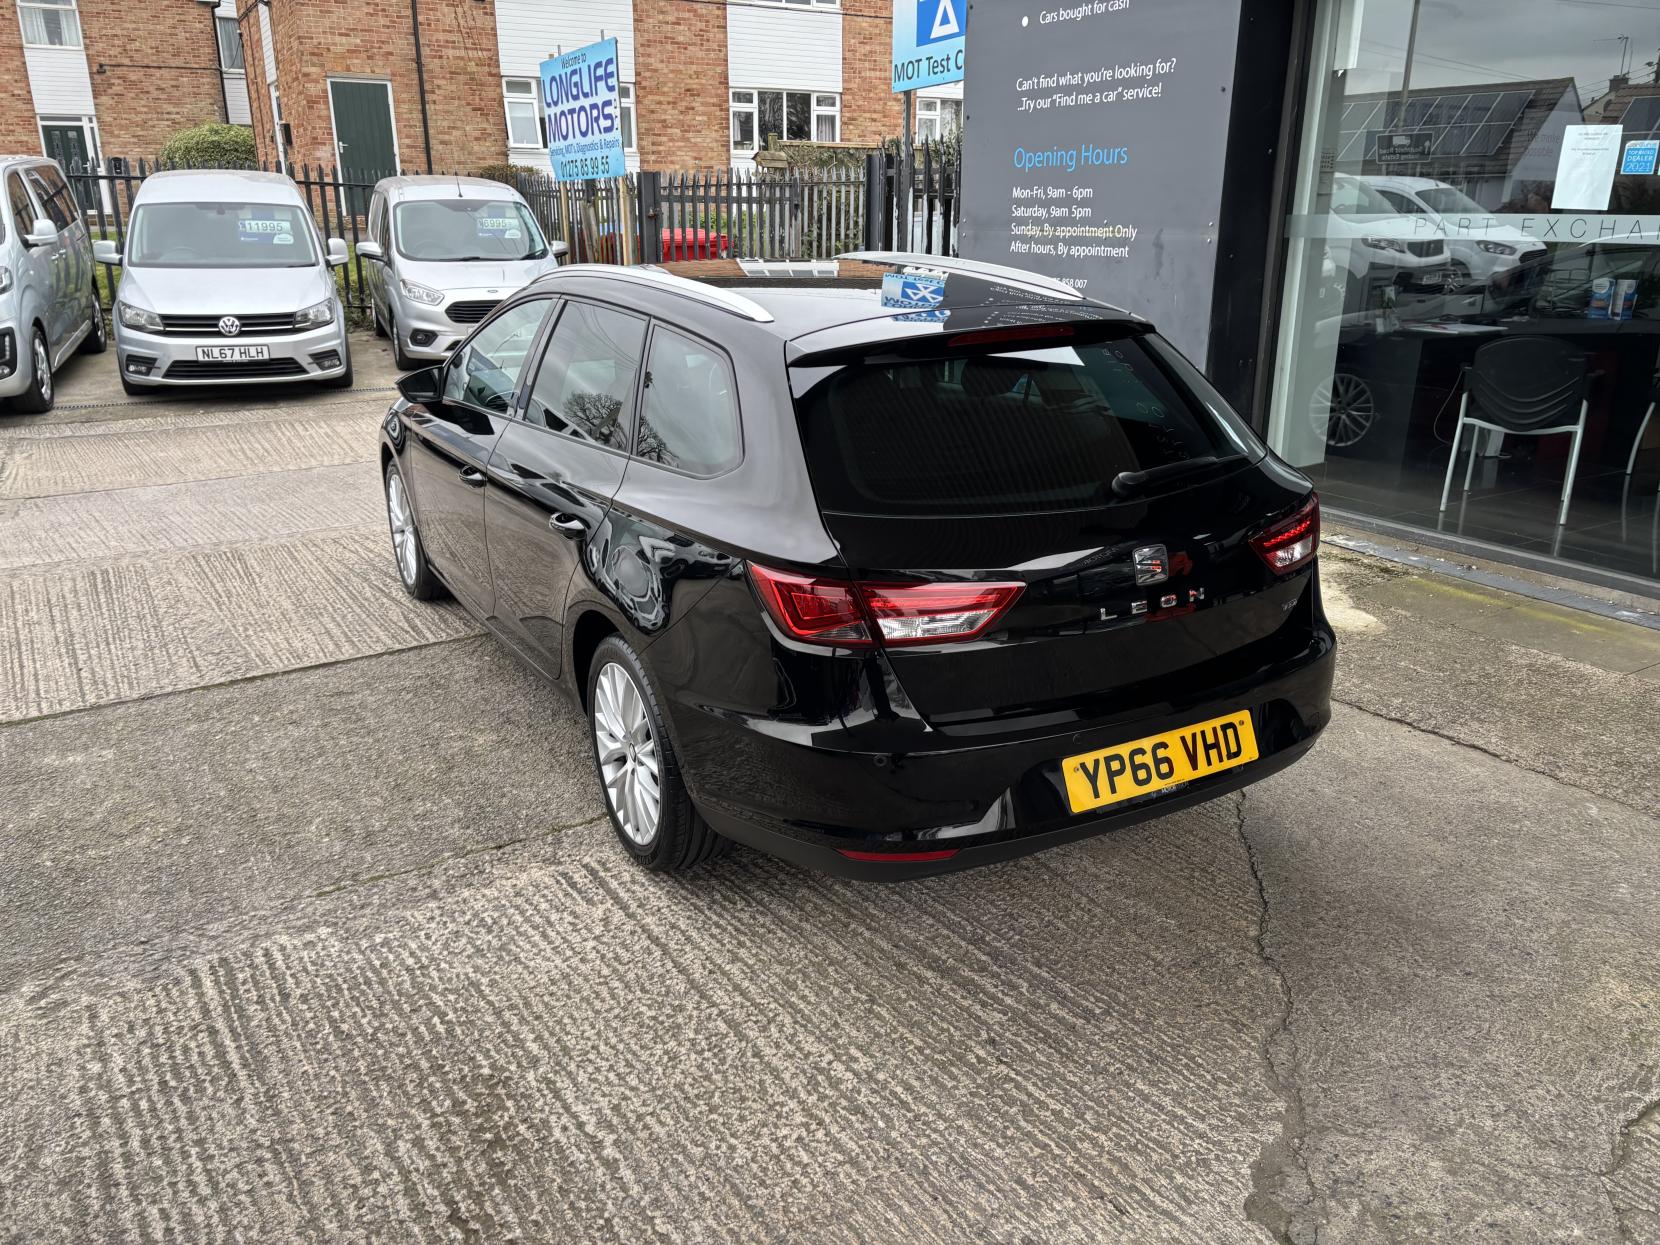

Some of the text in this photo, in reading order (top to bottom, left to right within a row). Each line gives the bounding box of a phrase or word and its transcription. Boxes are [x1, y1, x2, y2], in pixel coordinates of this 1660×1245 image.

[1040, 0, 1130, 24] Cars bought for cash
[561, 52, 587, 70] Welcome to
[894, 59, 922, 83] MOT
[926, 54, 951, 76] Test
[542, 57, 616, 108] LONGLIFE
[1016, 57, 1177, 91] Can't find what you're looking for?
[1036, 97, 1052, 109] our
[1077, 93, 1093, 105] me
[1094, 92, 1101, 103] a
[1122, 82, 1162, 100] service!
[547, 99, 615, 144] MOTORS
[599, 138, 604, 151] &
[604, 136, 620, 151] Repairs
[560, 155, 610, 178] 01275 85 99 55
[1014, 143, 1128, 173] Opening Hours
[1625, 162, 1651, 172] 2021
[1012, 186, 1046, 200] Mon-Fri,
[1047, 186, 1066, 198] 9am
[1072, 185, 1093, 201] 6pm
[1011, 204, 1092, 220] Saturday, 9am 5pm
[1011, 222, 1138, 241] Sunday, By appointment Only
[1414, 217, 1660, 240] PART EXCHA
[1010, 241, 1129, 258] After hours, By appointment
[1075, 279, 1088, 289] 007
[202, 347, 264, 360] NL67 HLH
[1100, 587, 1205, 621] LEON
[1079, 721, 1242, 799] YP66 VHD
